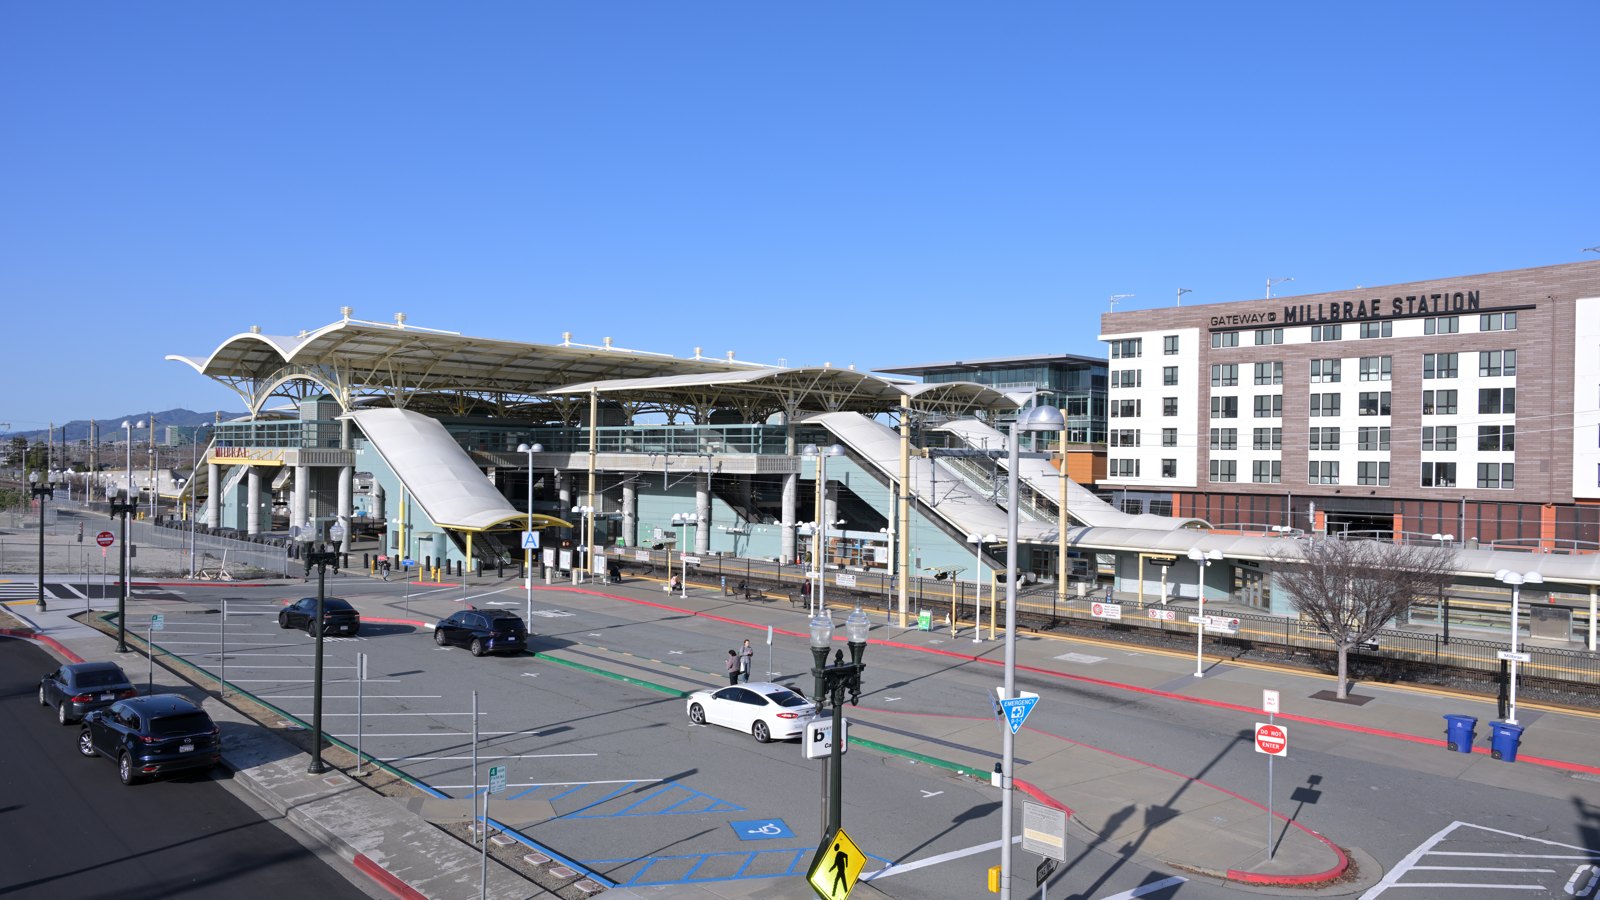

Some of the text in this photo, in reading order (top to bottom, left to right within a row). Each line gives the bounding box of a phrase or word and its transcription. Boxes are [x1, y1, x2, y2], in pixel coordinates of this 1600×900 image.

[1210, 312, 1266, 326] GATEWAY
[1284, 298, 1382, 323] MILLBRAE
[1392, 290, 1480, 317] STATION
[524, 532, 537, 547] A
[1004, 699, 1035, 707] EMERGENCY
[1262, 741, 1280, 750] ENTER
